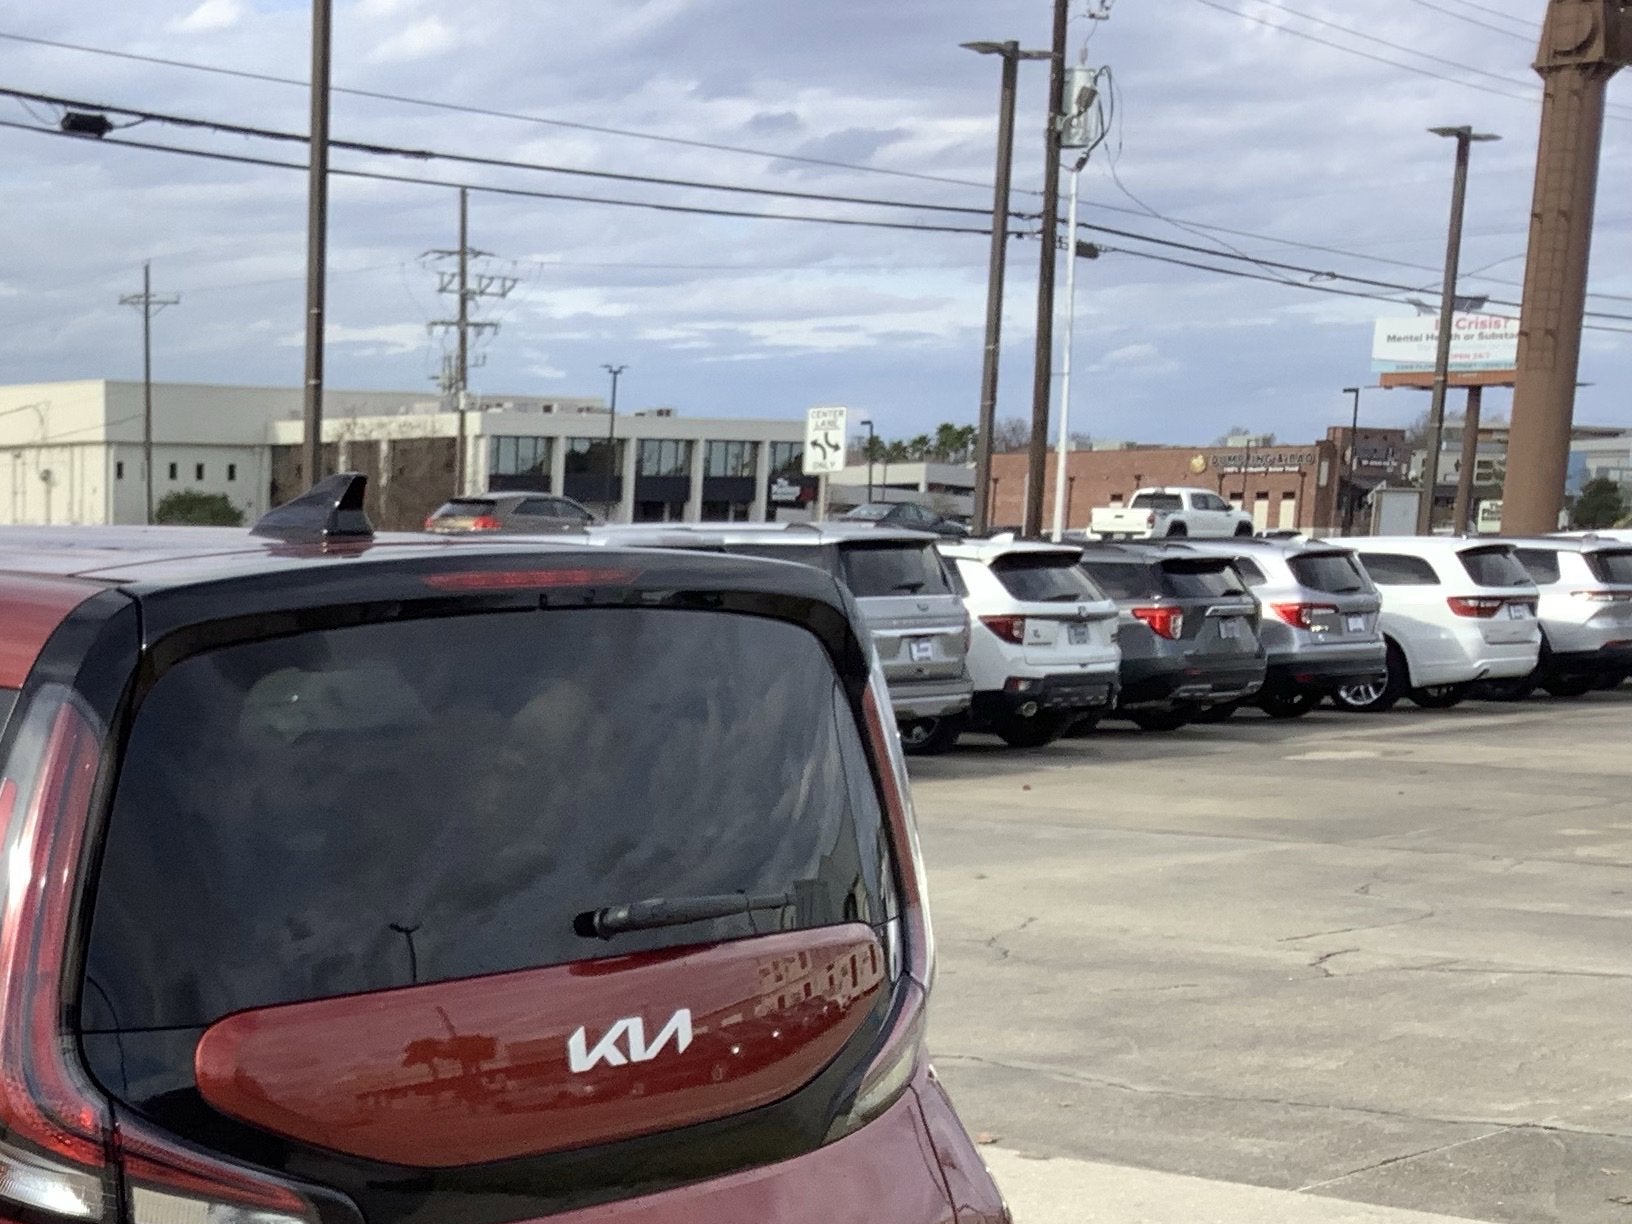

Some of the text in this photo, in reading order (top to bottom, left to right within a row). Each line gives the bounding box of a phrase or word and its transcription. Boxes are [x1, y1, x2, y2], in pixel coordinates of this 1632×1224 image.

[1386, 333, 1423, 343] Mental
[1425, 332, 1461, 342] Heth
[1463, 333, 1475, 341] or
[811, 409, 844, 419] CENTER
[815, 419, 838, 428] LANE
[812, 460, 836, 470] ONLY
[568, 1008, 693, 1073] KIA
